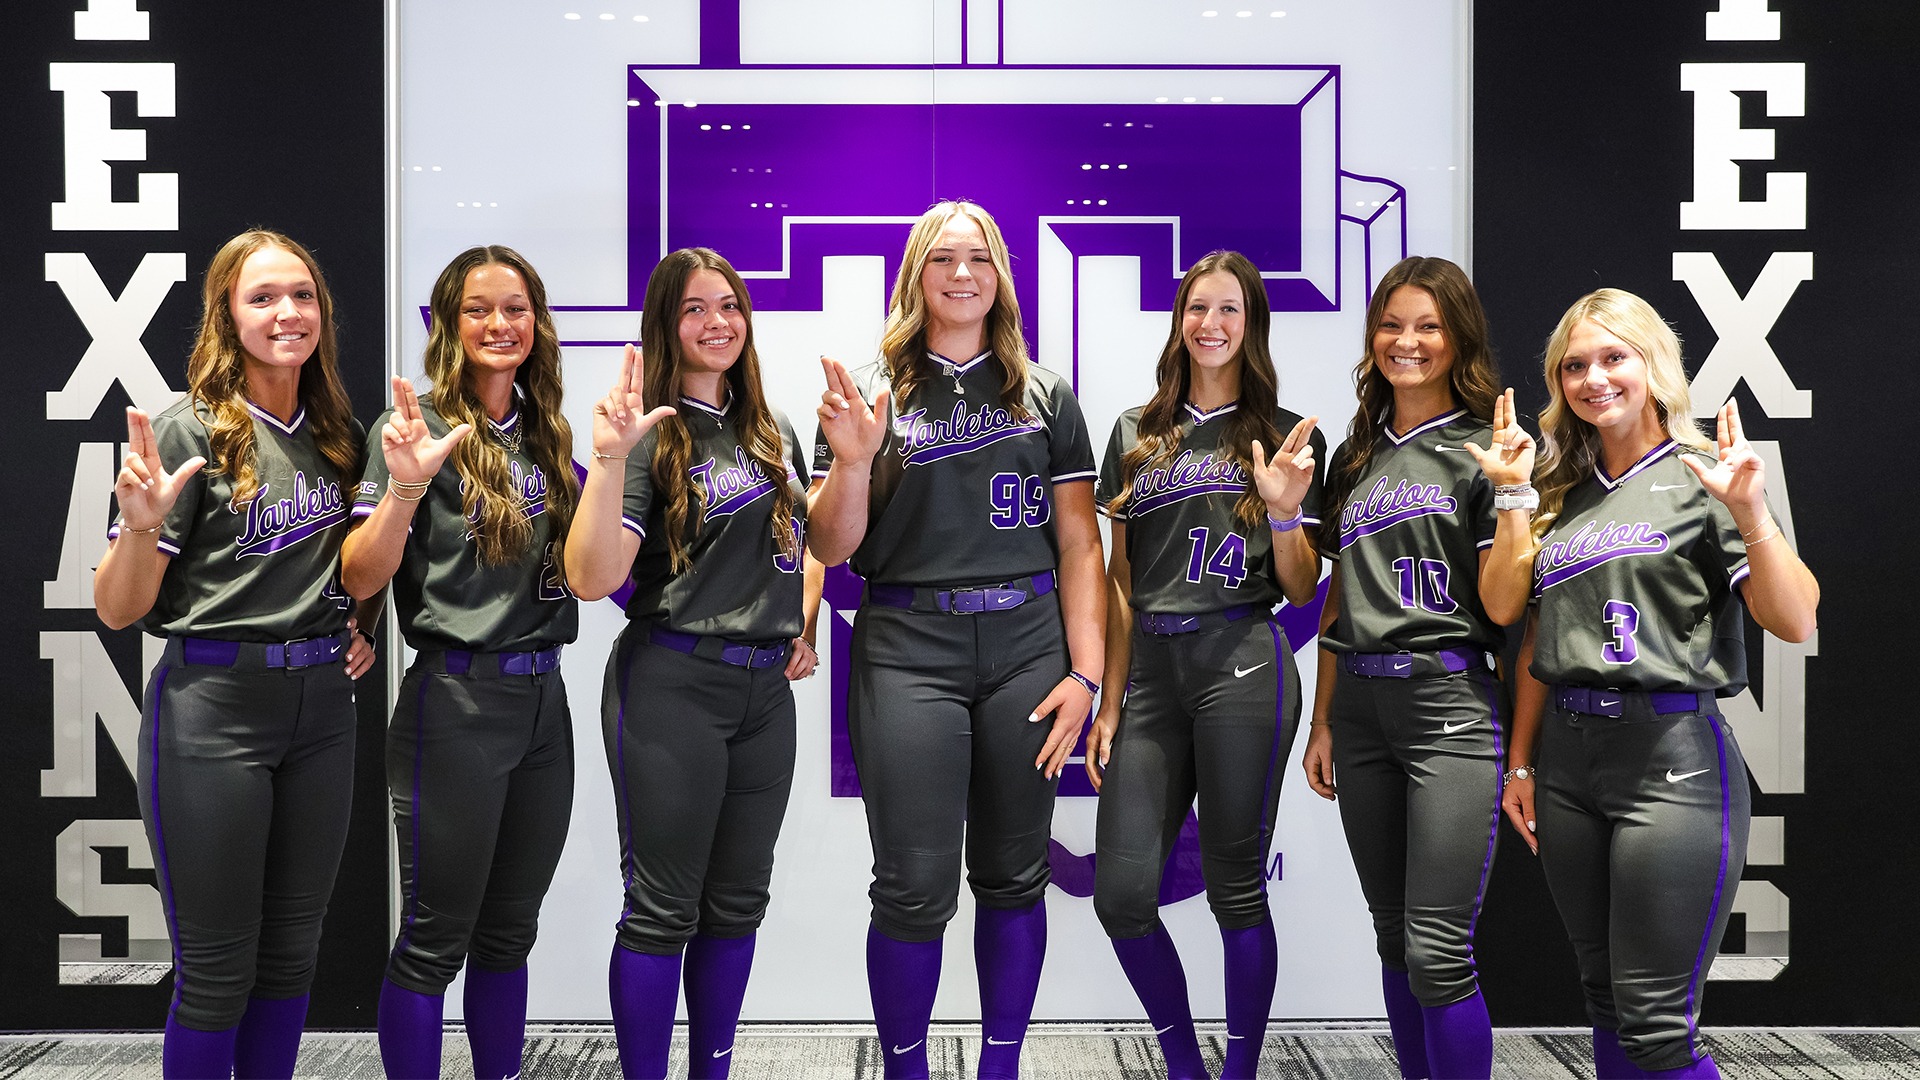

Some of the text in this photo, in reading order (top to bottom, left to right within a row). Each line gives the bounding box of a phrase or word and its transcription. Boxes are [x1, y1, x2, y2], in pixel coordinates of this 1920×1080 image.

[689, 445, 797, 509] Tarle
[989, 472, 1051, 530] 99
[1339, 475, 1457, 533] arleton
[228, 470, 345, 547] Tarleto
[771, 516, 808, 574] 3
[1185, 526, 1248, 589] 14
[1534, 520, 1671, 580] arleton
[1391, 556, 1460, 615] 10
[1600, 600, 1641, 666] 3
